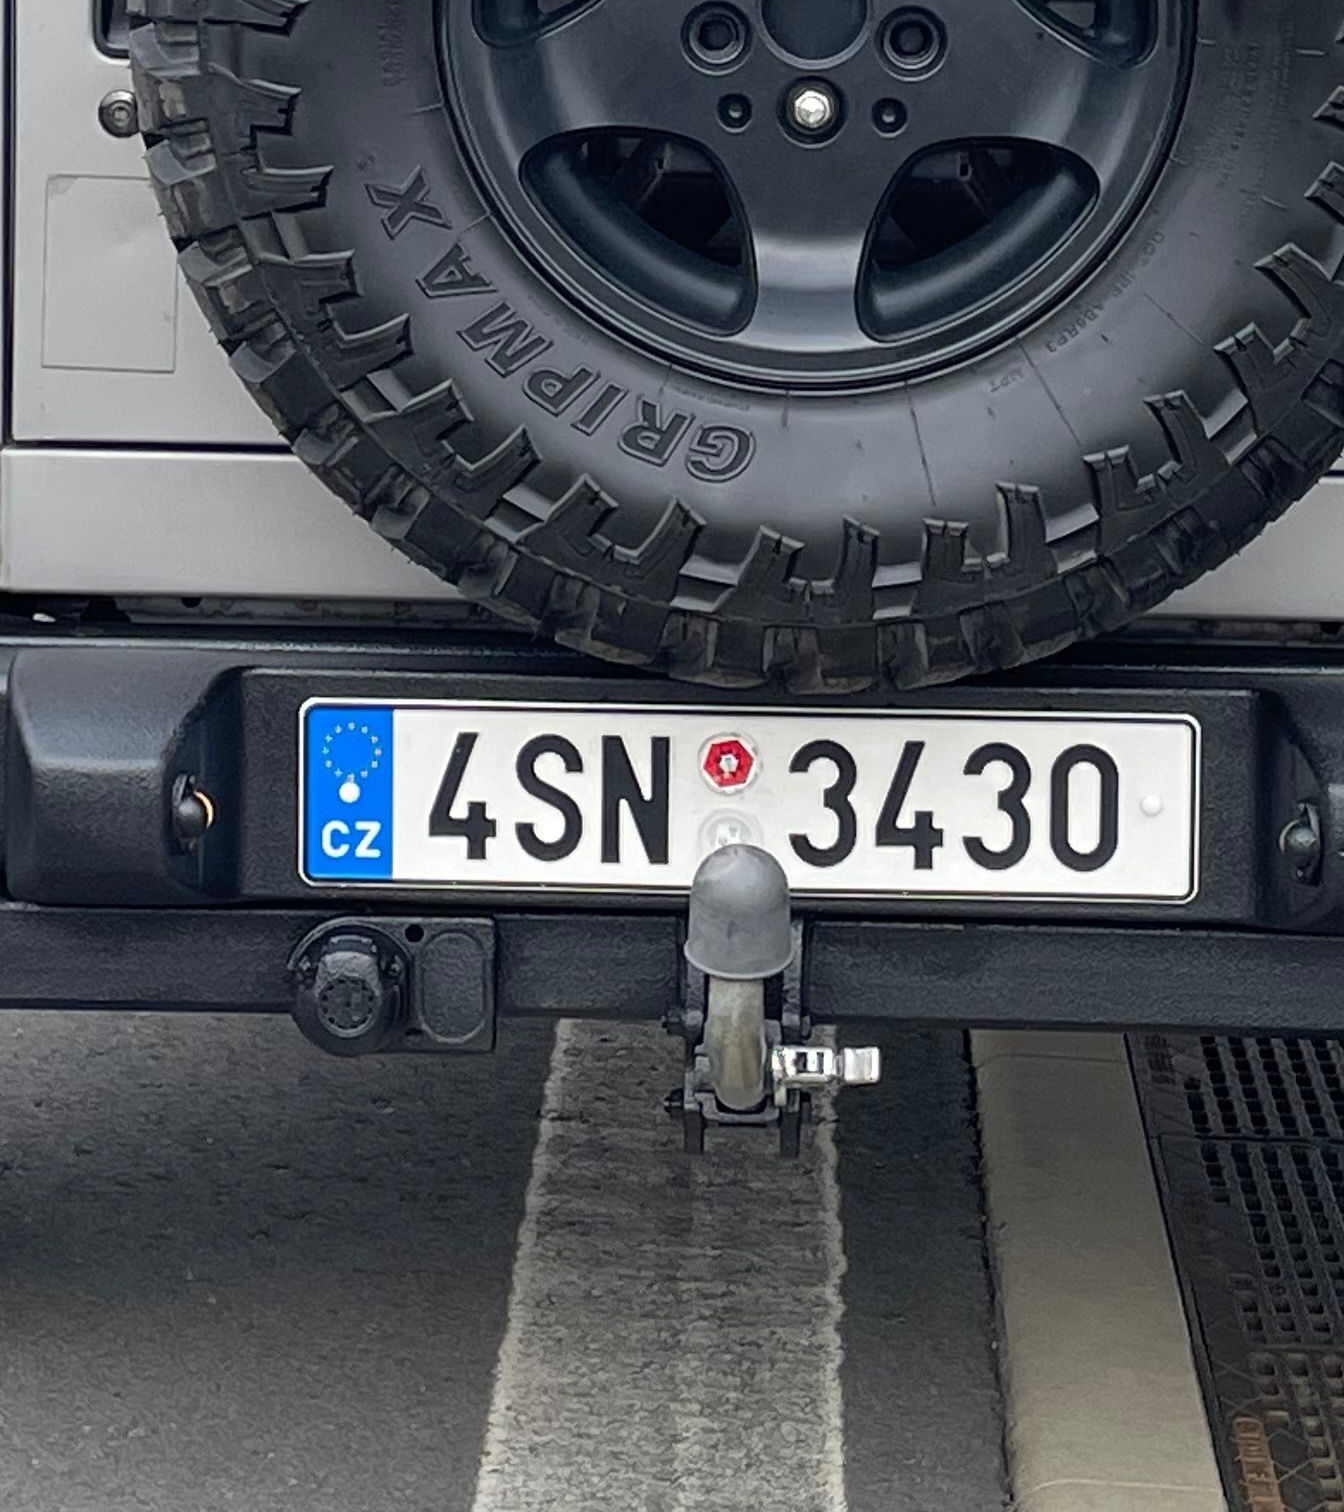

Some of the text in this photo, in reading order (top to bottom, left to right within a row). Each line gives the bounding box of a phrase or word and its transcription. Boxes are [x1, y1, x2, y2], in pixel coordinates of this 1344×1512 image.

[364, 163, 757, 483] GRIPMAX
[321, 819, 382, 859] CZ
[427, 731, 1121, 873] 4SN 3430
